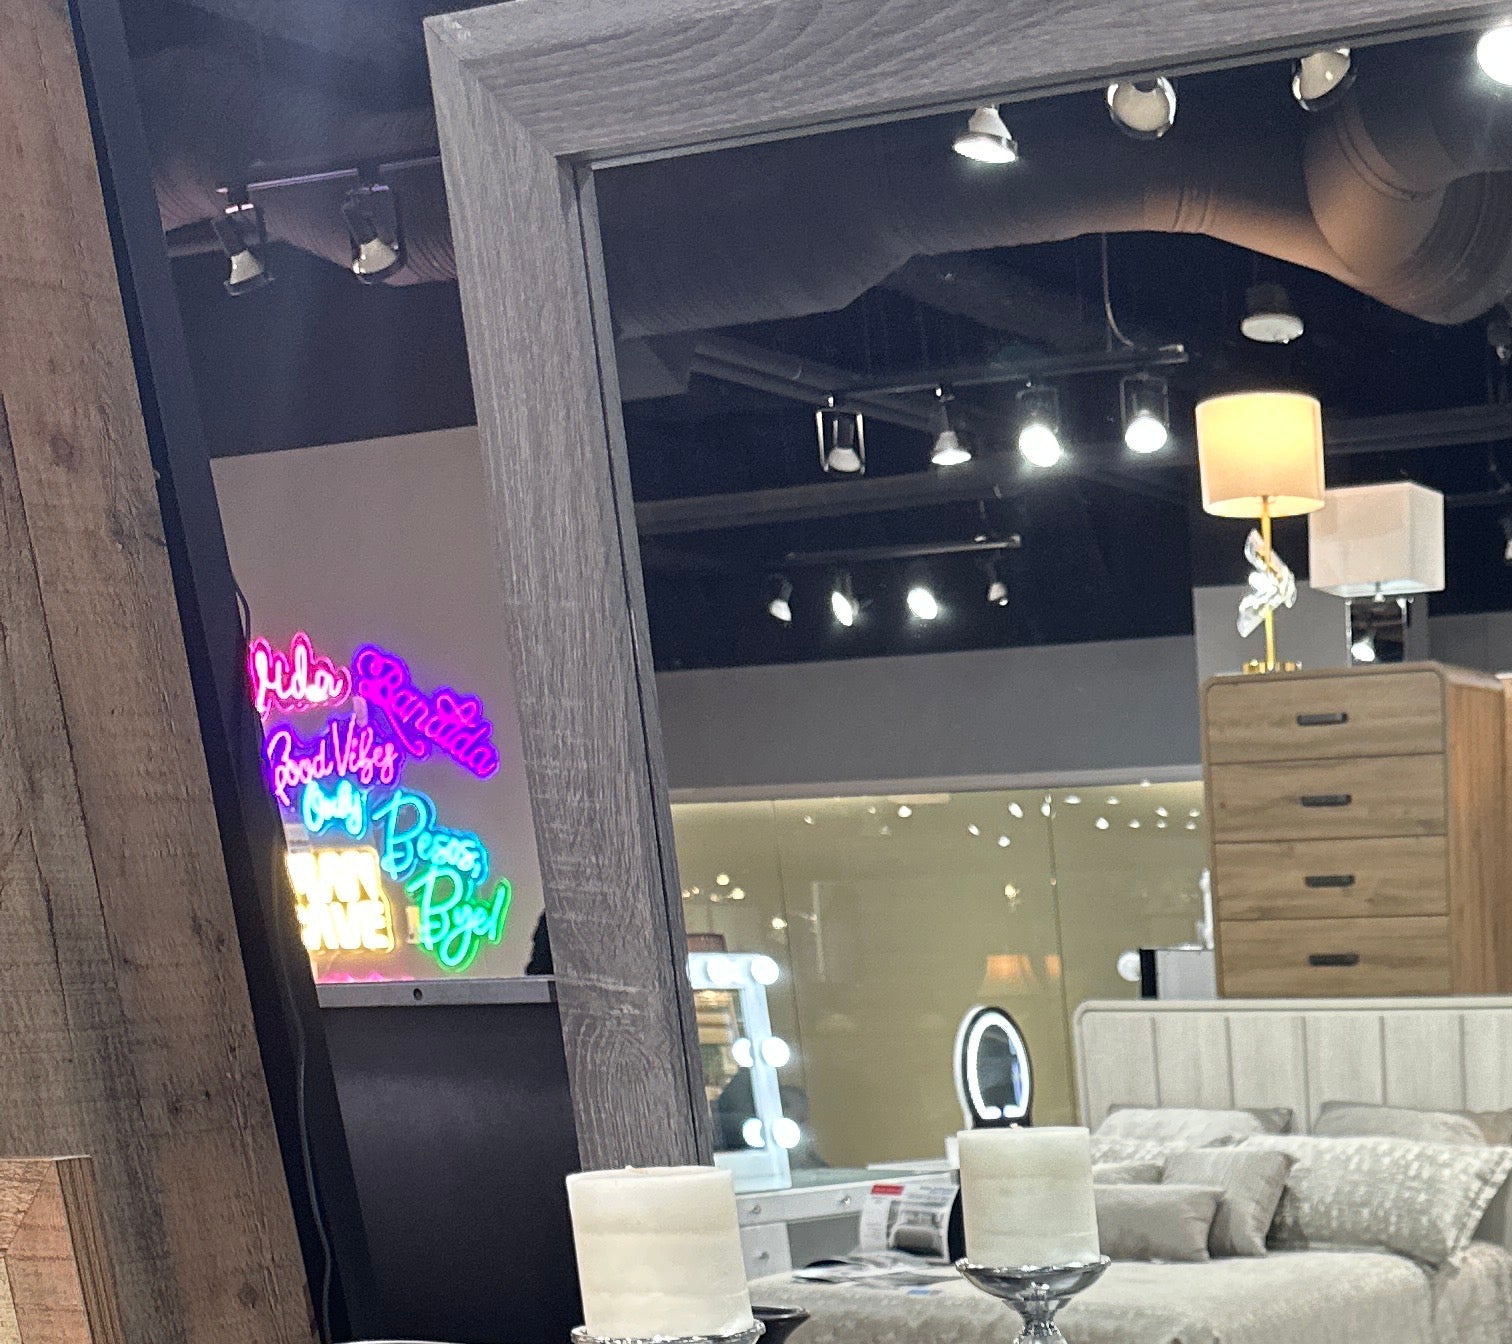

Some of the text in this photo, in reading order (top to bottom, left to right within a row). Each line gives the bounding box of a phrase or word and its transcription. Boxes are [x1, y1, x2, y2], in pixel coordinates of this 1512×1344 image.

[266, 712, 399, 806] Good Vibes
[302, 779, 365, 836] Only
[407, 868, 508, 967] Bye!
